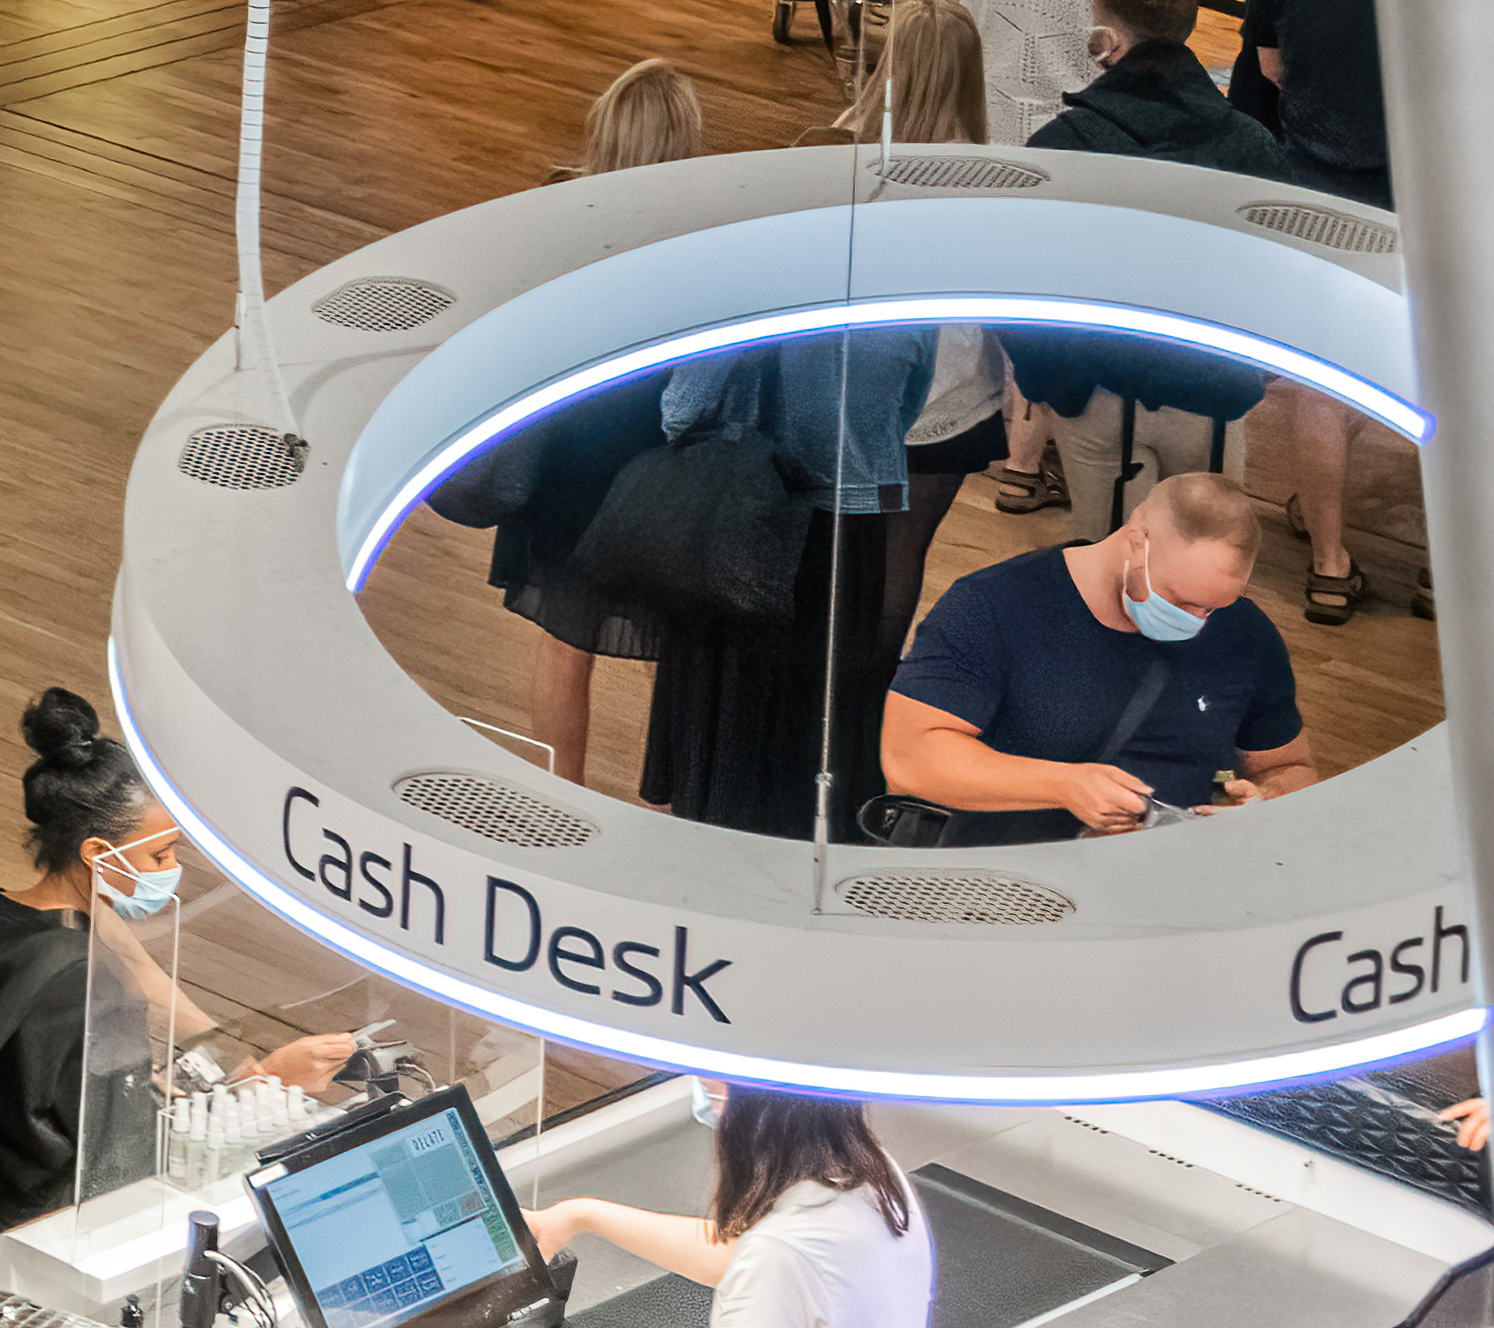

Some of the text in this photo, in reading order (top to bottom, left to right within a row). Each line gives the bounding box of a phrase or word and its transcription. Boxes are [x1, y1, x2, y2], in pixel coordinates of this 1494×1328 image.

[281, 786, 733, 1027] Cash Desk
[1288, 905, 1472, 1025] Cash
